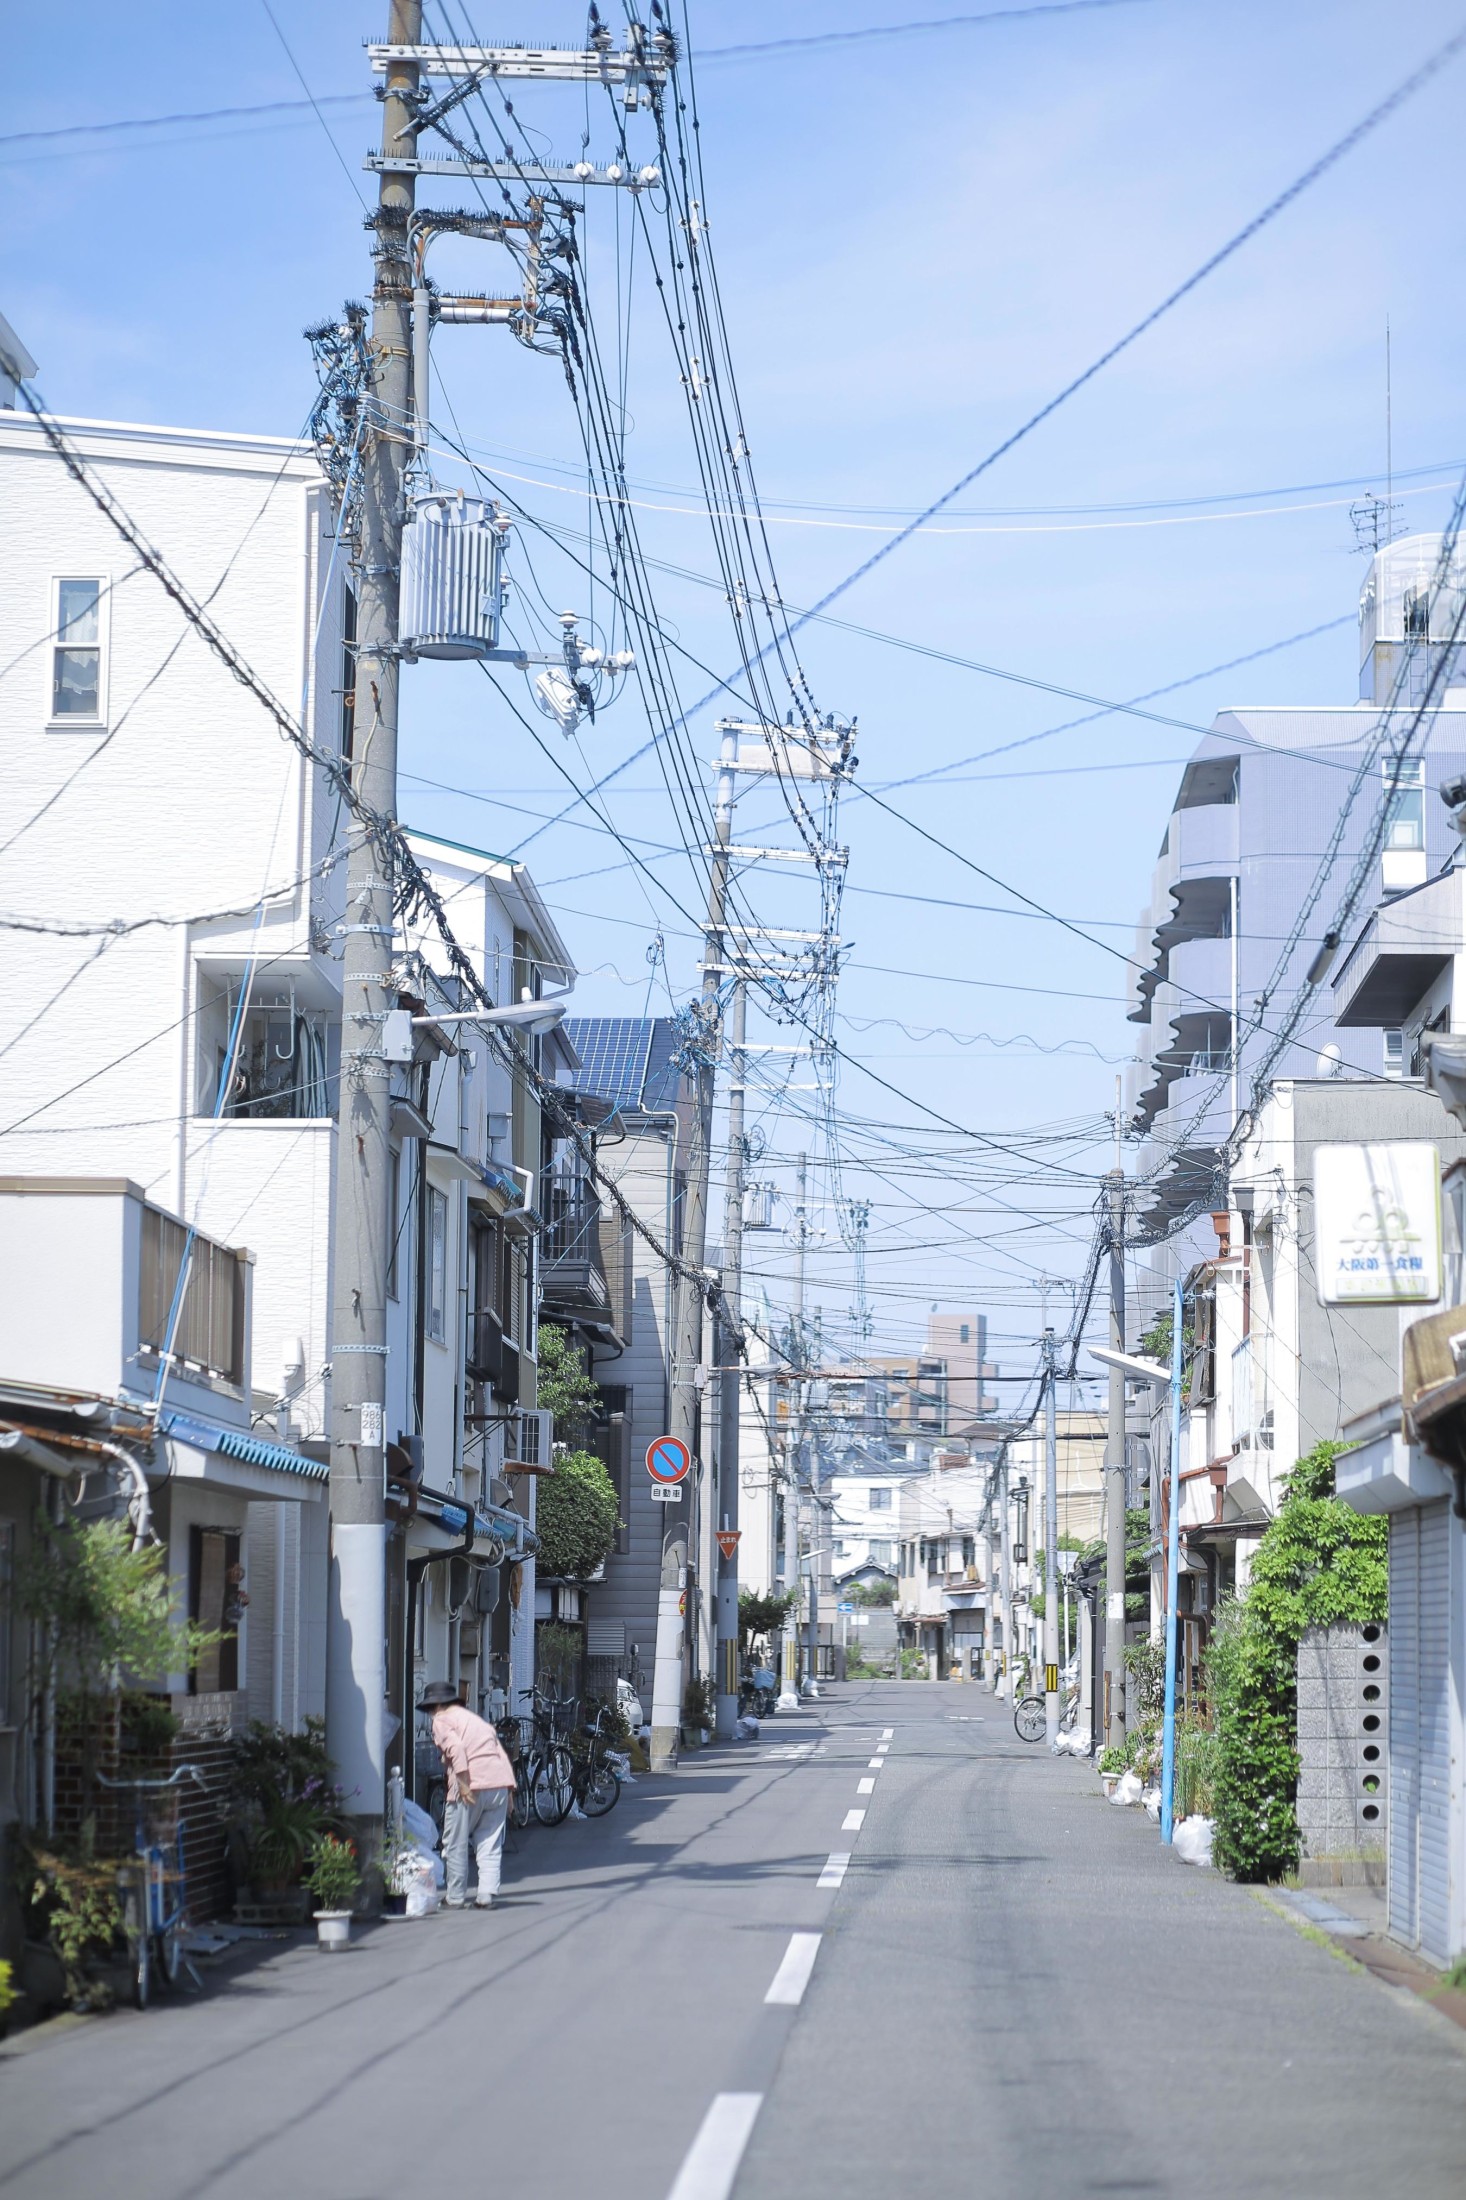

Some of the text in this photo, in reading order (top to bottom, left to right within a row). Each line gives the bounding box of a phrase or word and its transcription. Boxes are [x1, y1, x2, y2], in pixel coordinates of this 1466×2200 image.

[362, 1410, 381, 1420] 986
[362, 1419, 381, 1430] 282
[369, 1430, 375, 1440] A
[653, 1488, 681, 1499] 自動車
[720, 1536, 737, 1544] 止まれ
